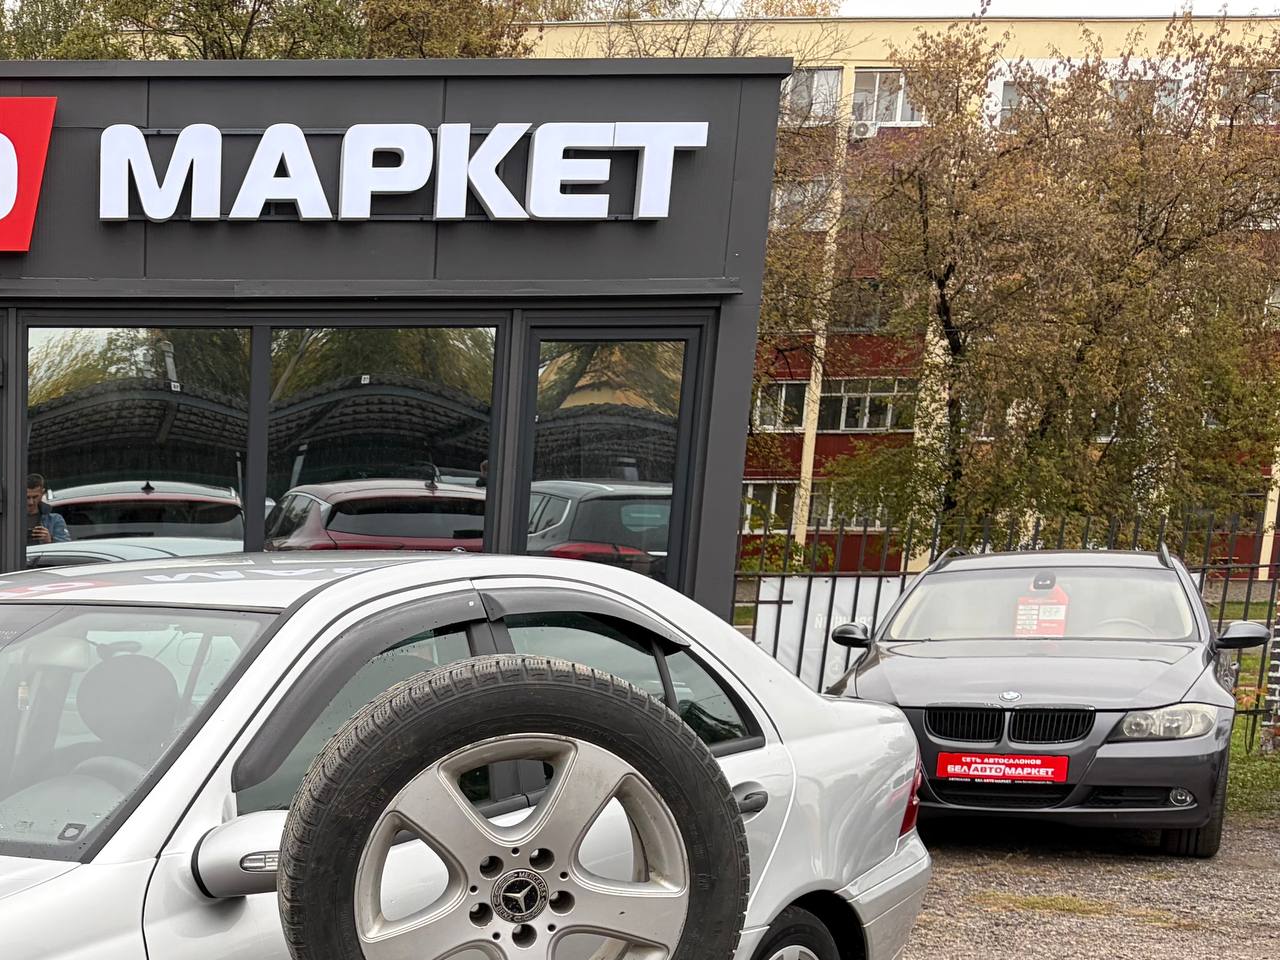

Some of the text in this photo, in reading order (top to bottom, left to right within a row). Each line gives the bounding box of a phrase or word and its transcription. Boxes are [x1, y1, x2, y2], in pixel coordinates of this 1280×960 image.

[99, 122, 709, 222] МАРКЕТ
[947, 765, 1055, 776] БЕЛ АВТО МАРКЕТ
[518, 872, 546, 897] MERCEDES
